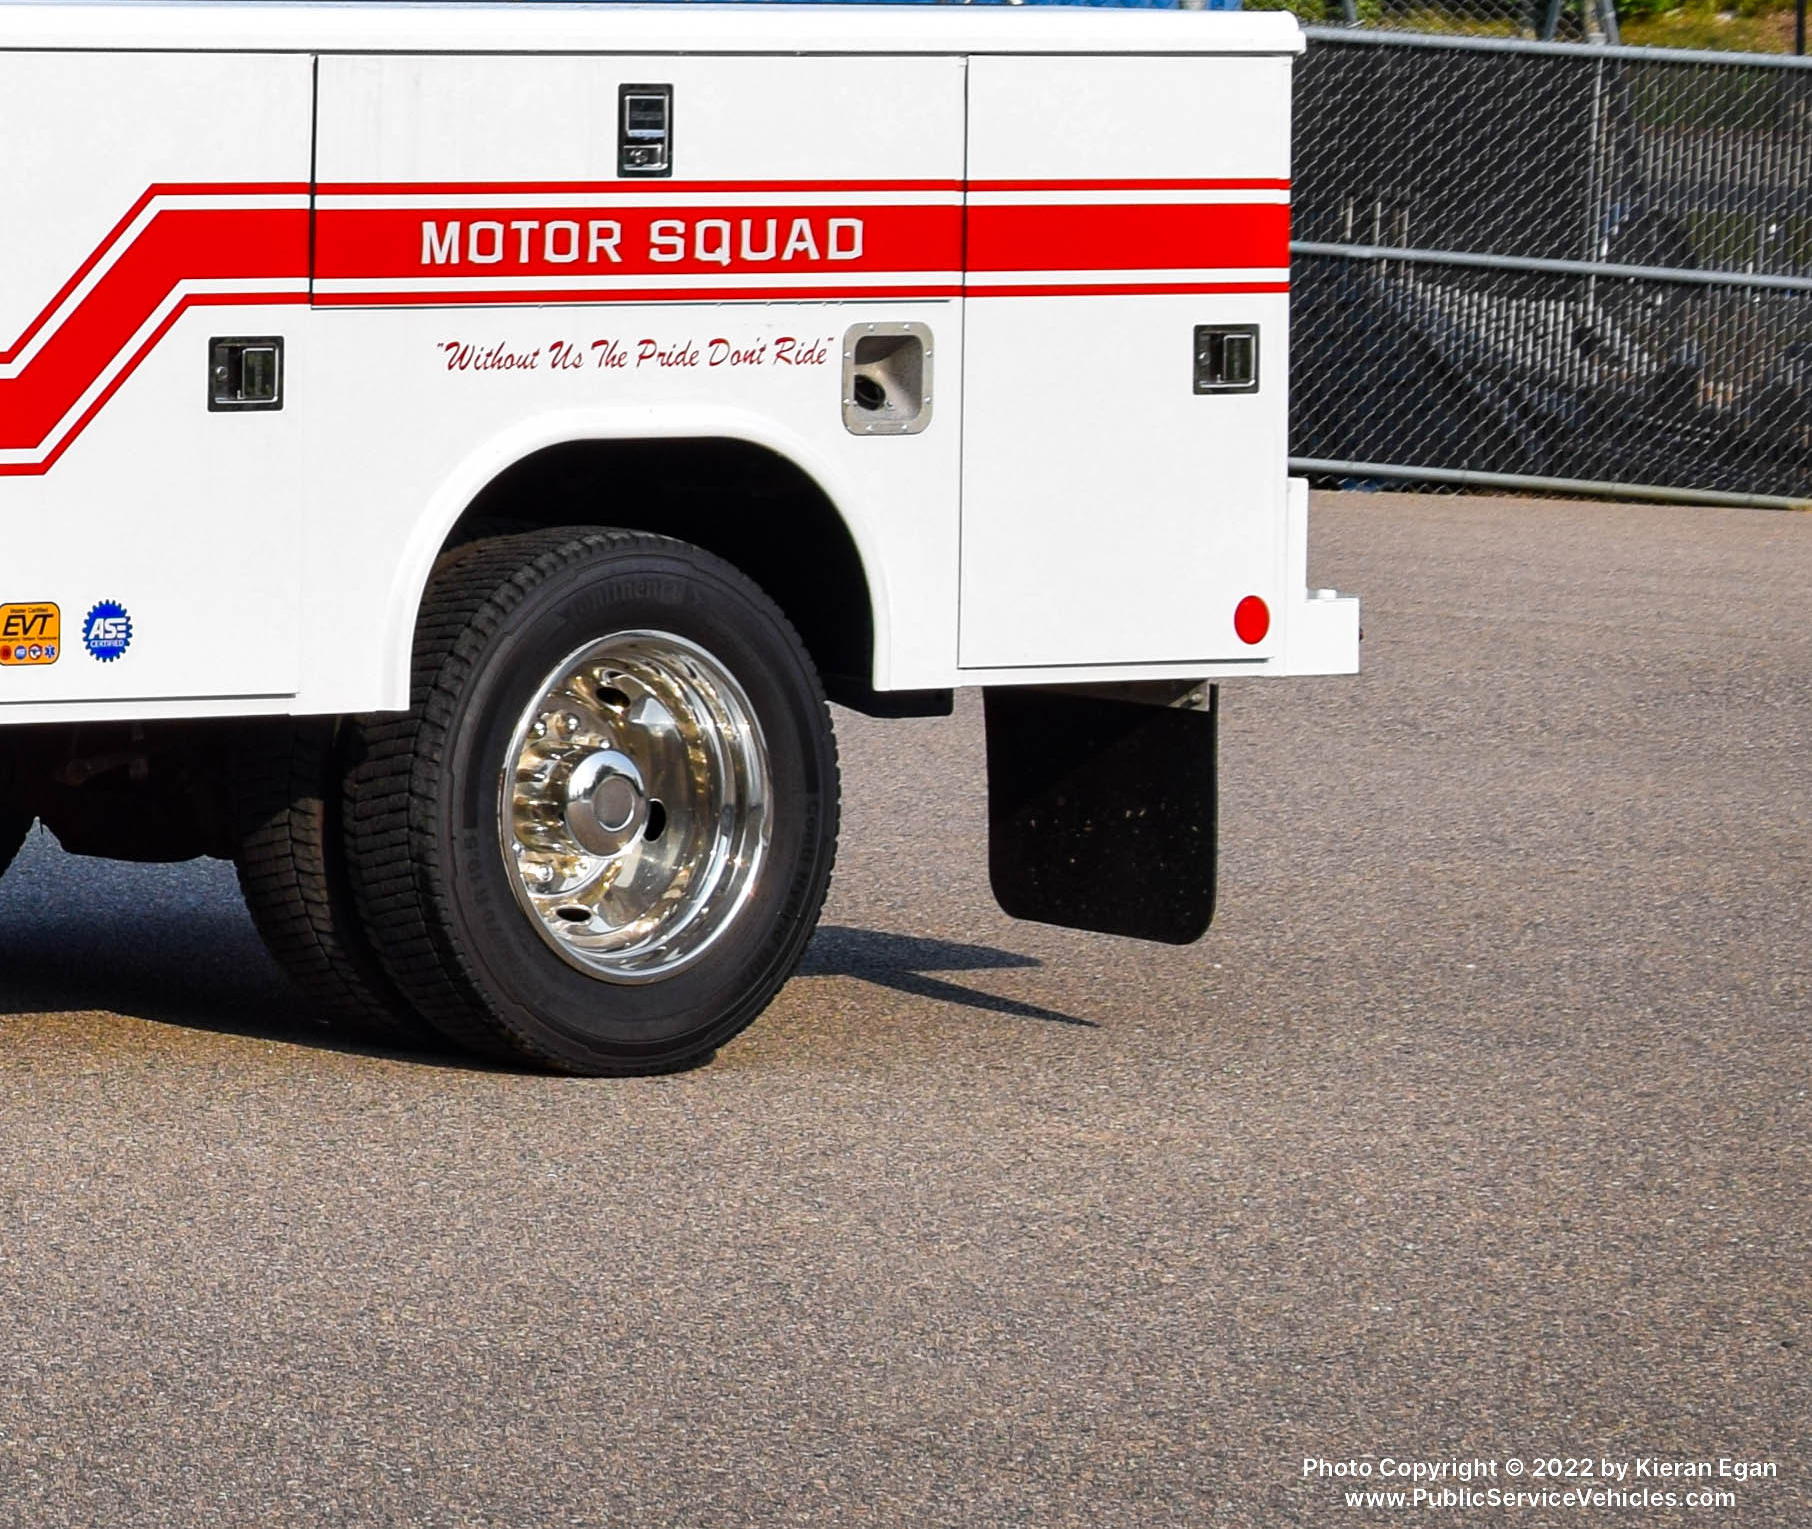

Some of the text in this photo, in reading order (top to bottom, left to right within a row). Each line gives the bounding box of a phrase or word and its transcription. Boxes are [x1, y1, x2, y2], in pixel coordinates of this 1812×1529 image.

[420, 217, 864, 267] MOTOR SQUAD
[548, 340, 584, 370] Us
[590, 339, 628, 369] The
[636, 338, 700, 368] Pride
[708, 337, 768, 367] Don't
[2, 613, 54, 636] EVT
[87, 617, 127, 640] ASE
[89, 639, 125, 648] CERTIFIED
